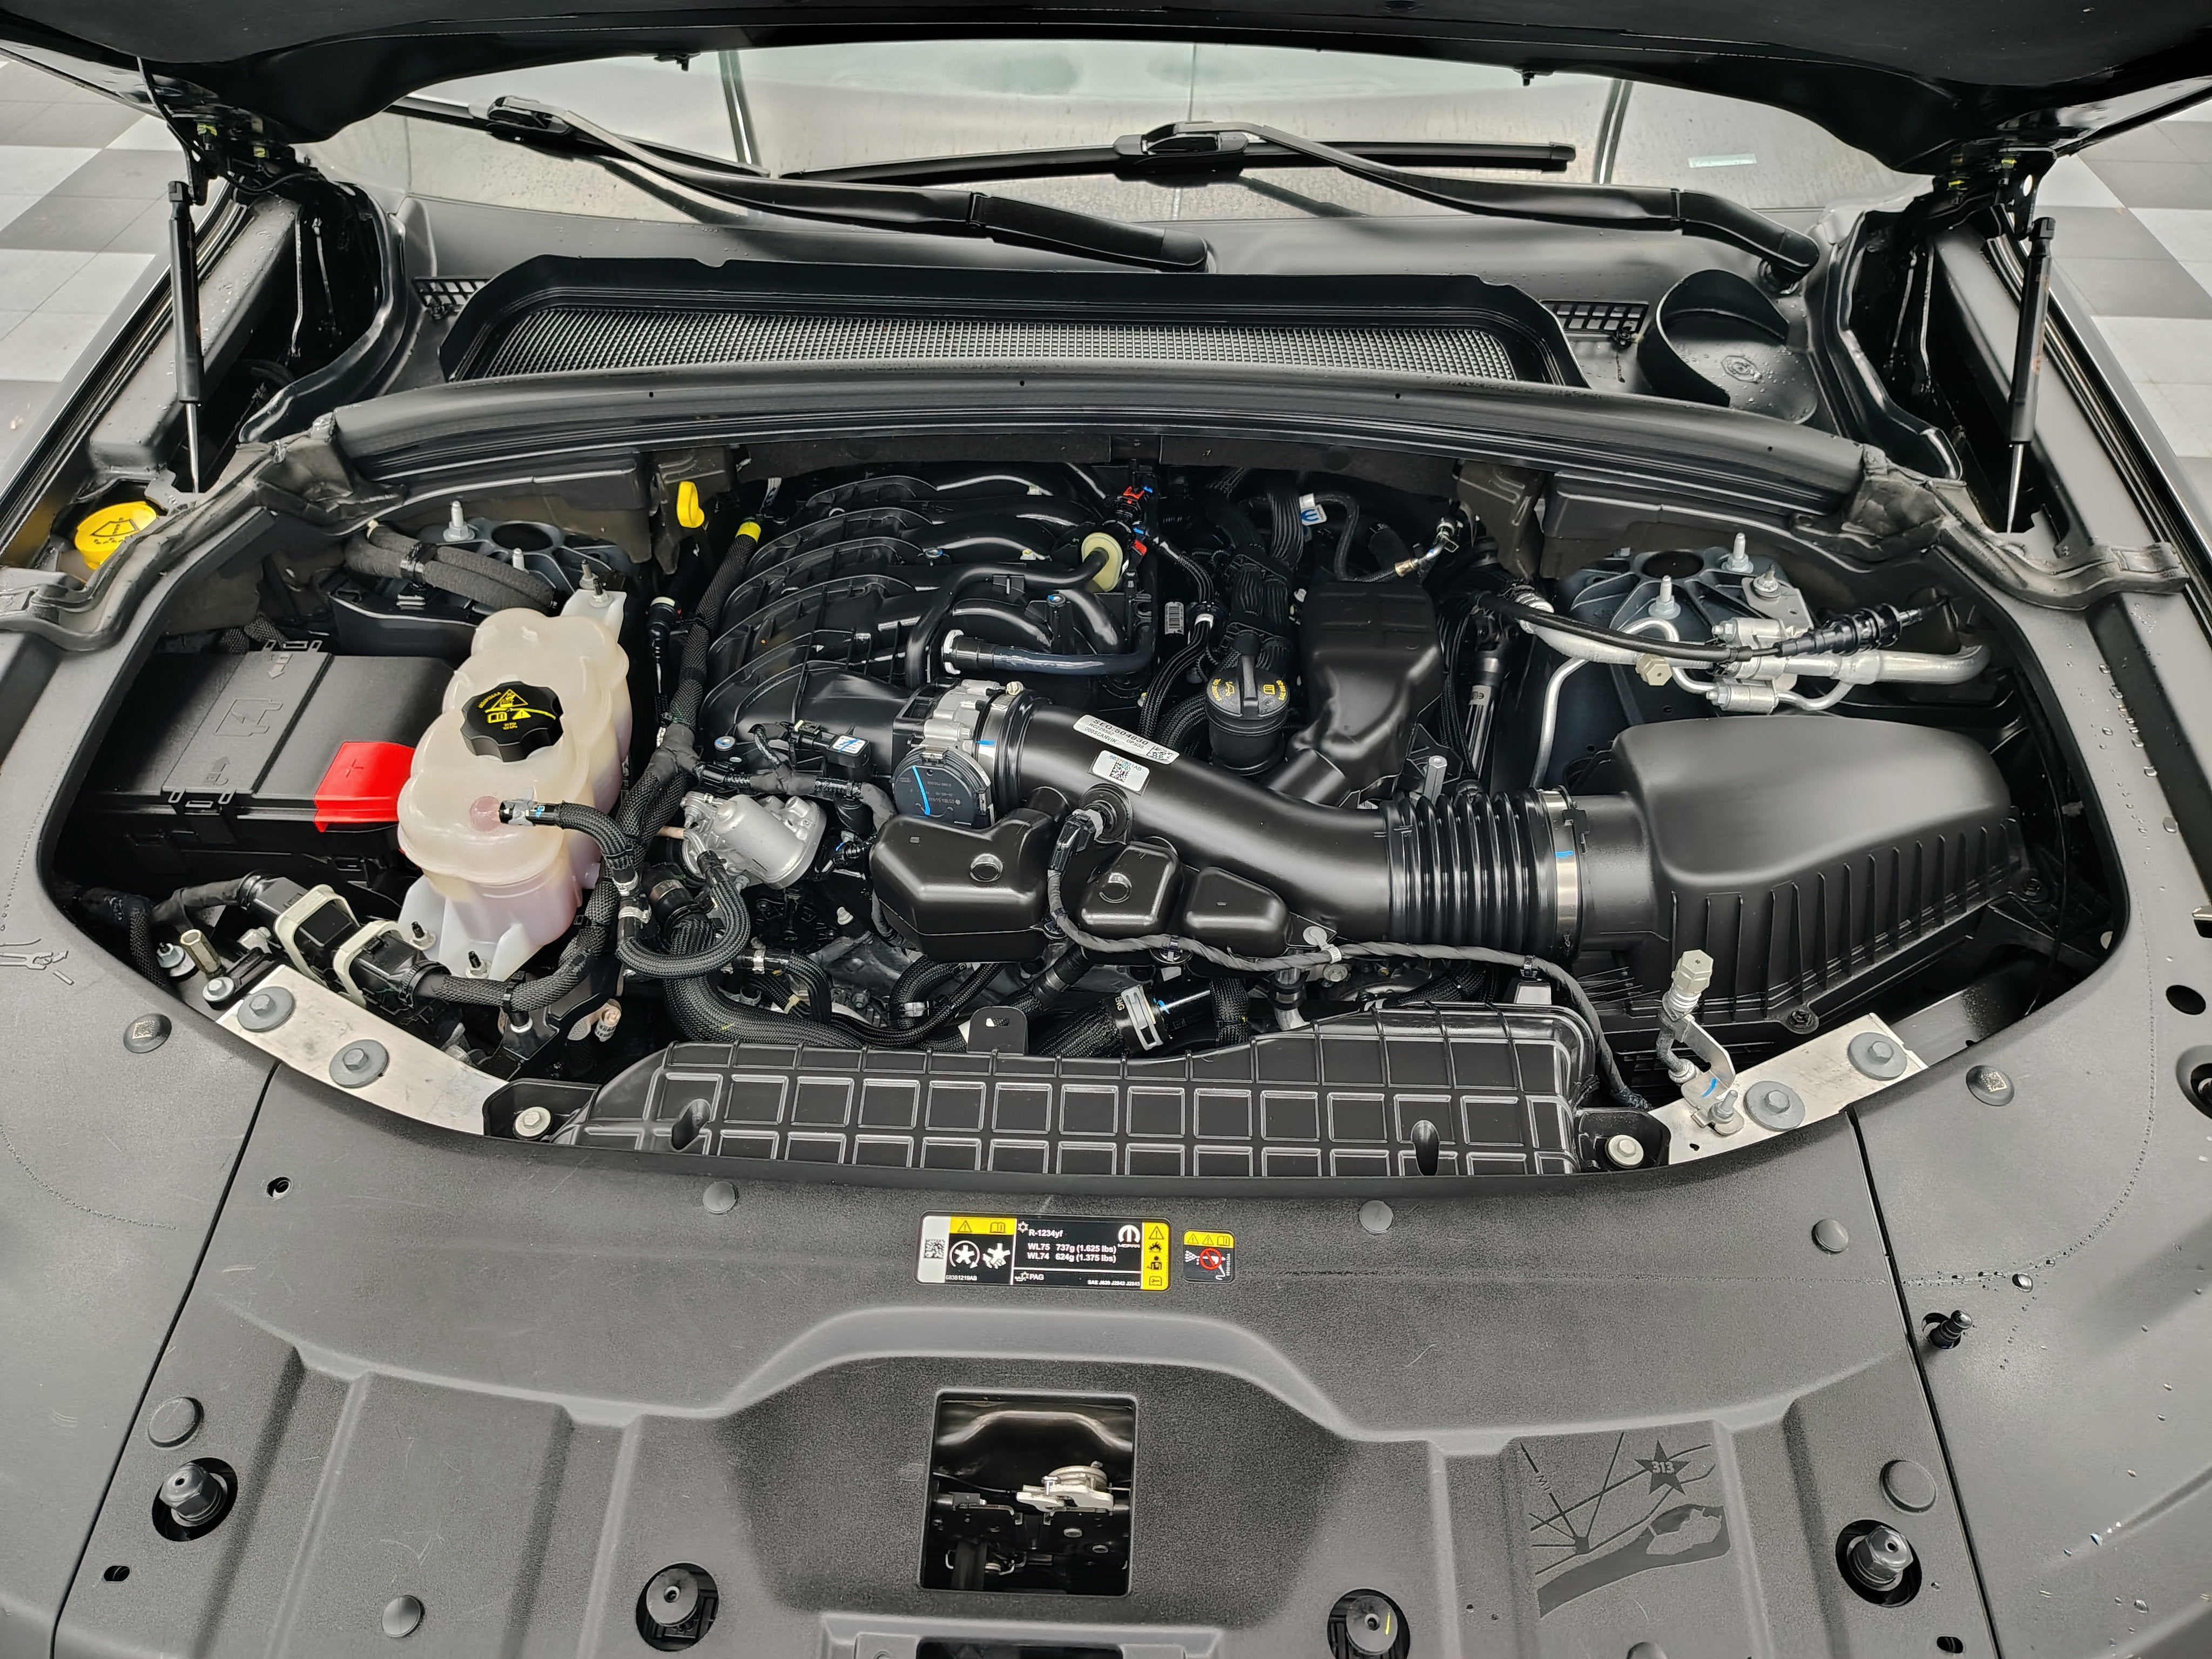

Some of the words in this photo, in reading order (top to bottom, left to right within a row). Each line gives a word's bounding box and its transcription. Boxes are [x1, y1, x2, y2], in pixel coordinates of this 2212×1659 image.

[1211, 685, 1222, 701] ENGINE
[1115, 996, 1125, 1011] ENG
[1028, 1229, 1064, 1238] R-1234yf
[1028, 1243, 1050, 1251] WL75
[1056, 1244, 1075, 1253] 737g
[1076, 1244, 1100, 1253] (1.625
[1101, 1245, 1117, 1254] lbs)
[1055, 1253, 1075, 1262] 624g
[1076, 1253, 1100, 1263] (1.375
[1101, 1255, 1117, 1263] lbs)
[1651, 1460, 1674, 1474] 313
